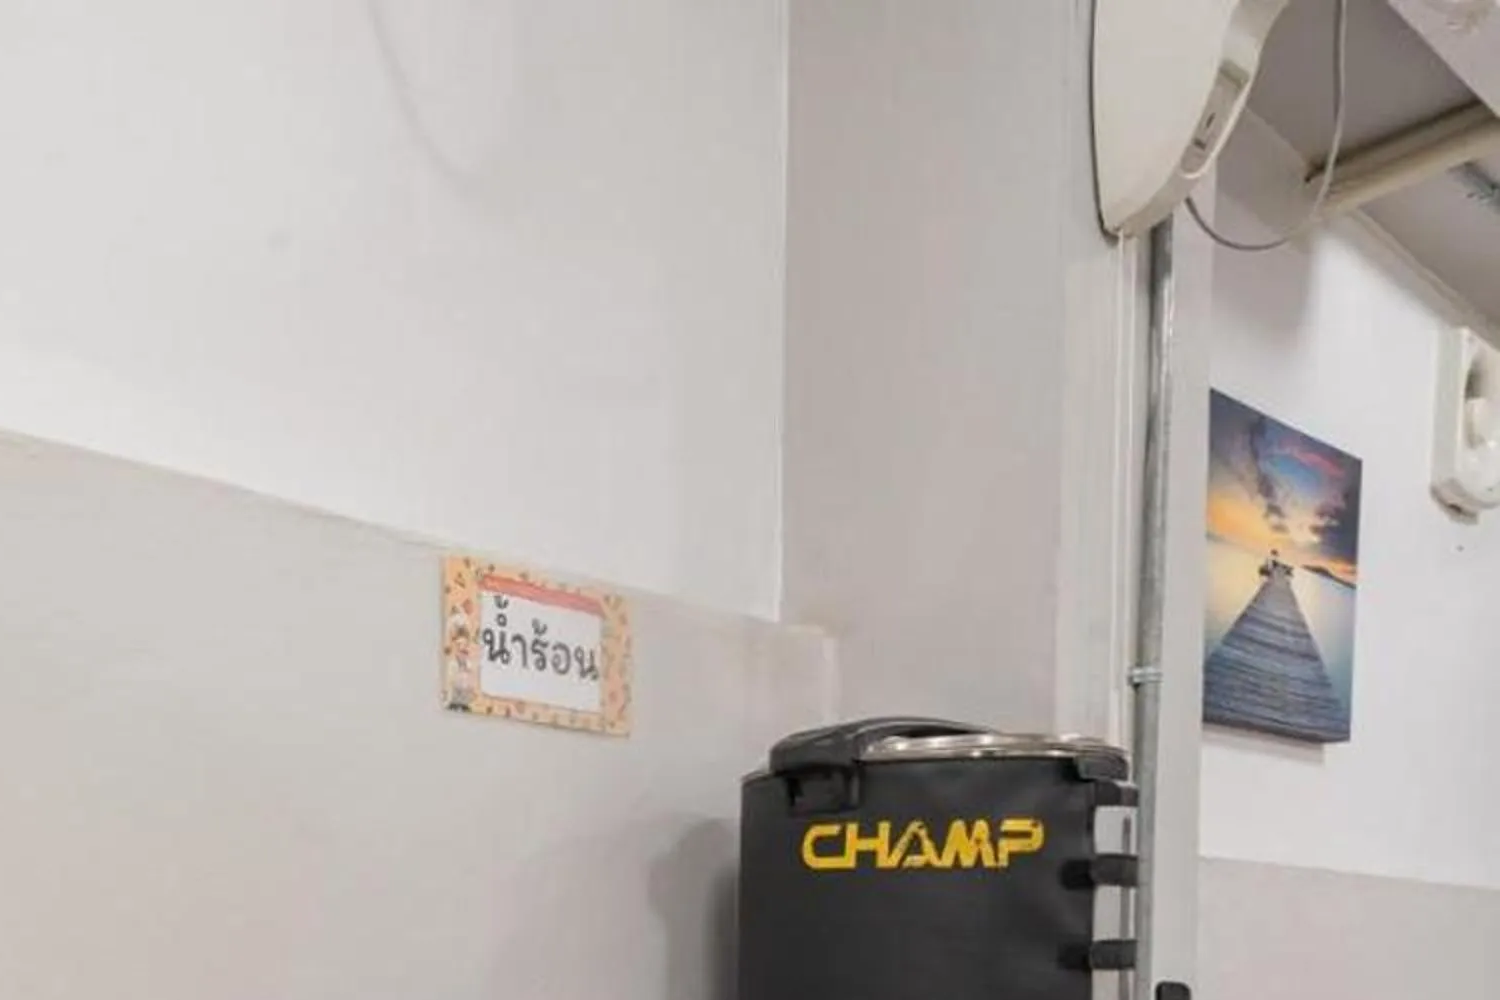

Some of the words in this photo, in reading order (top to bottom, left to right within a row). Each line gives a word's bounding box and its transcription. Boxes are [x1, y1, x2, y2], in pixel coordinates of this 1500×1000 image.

[481, 595, 600, 681] น้ำร้อน
[802, 818, 1045, 870] CHAMP
